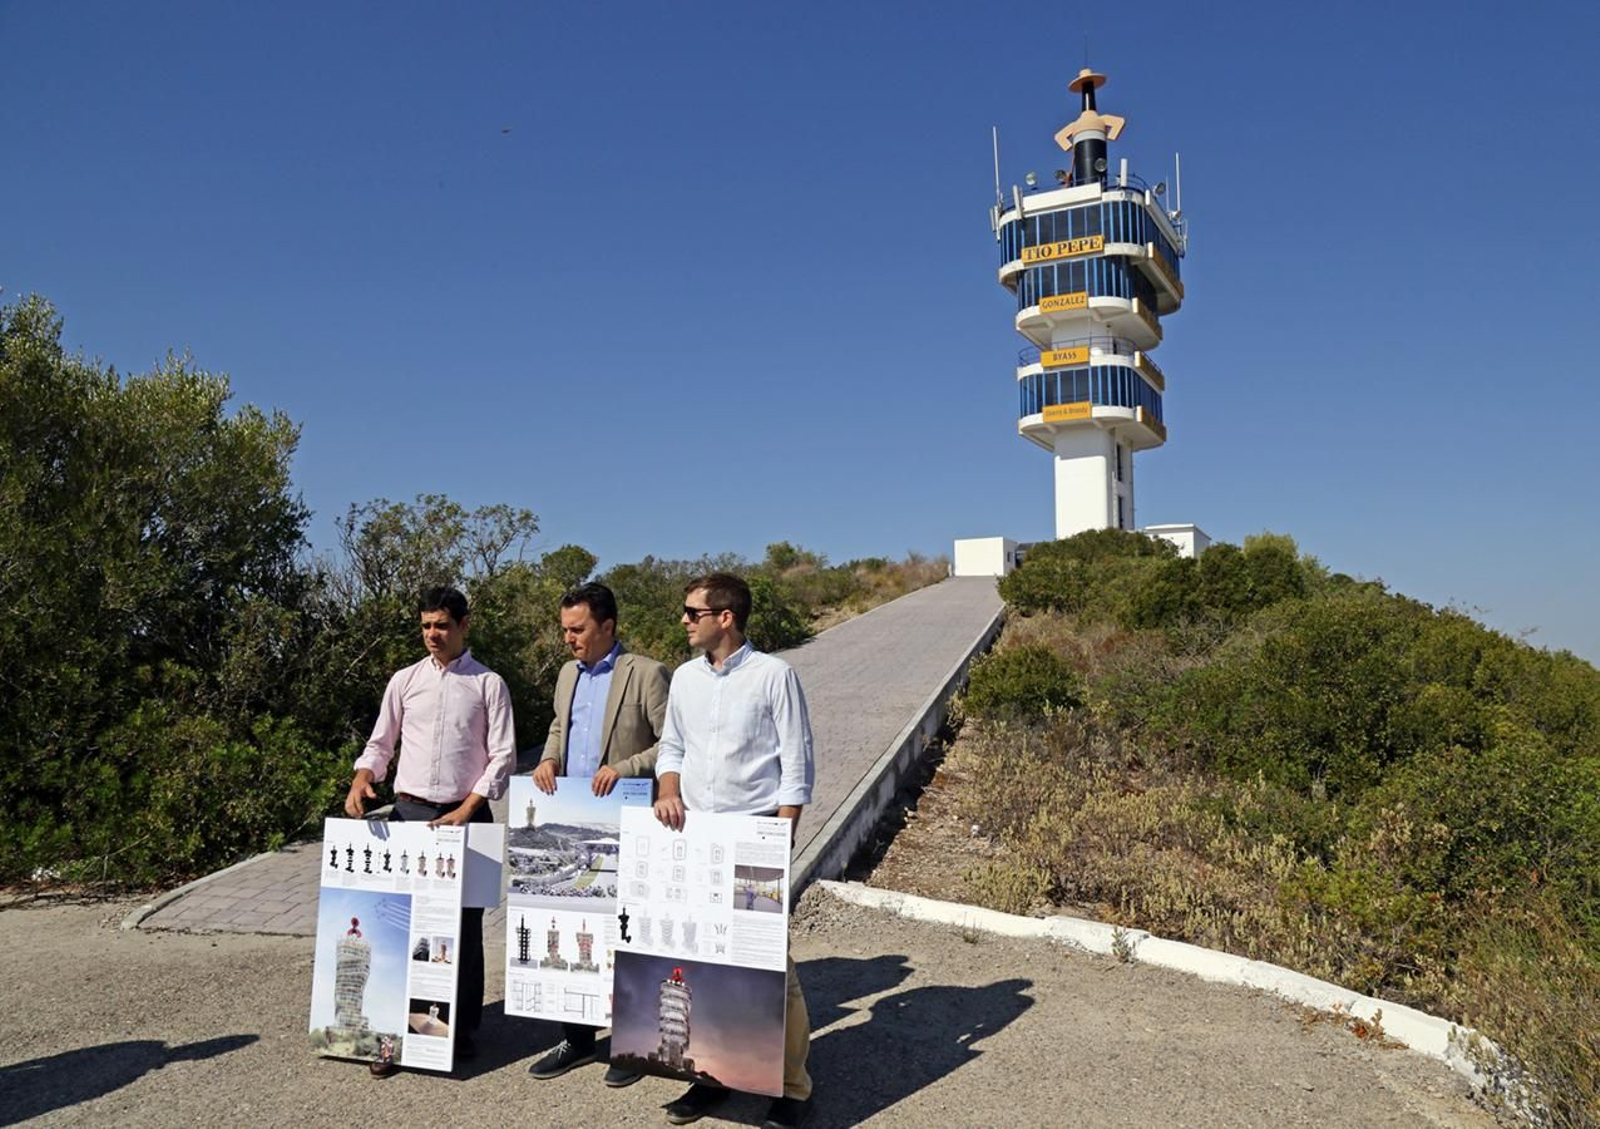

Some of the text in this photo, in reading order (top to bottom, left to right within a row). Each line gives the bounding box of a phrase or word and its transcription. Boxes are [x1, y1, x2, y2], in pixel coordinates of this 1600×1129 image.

[1024, 237, 1100, 260] TIO PEPE
[1042, 295, 1085, 308] GONZALEZ
[1053, 351, 1077, 361] BYASS
